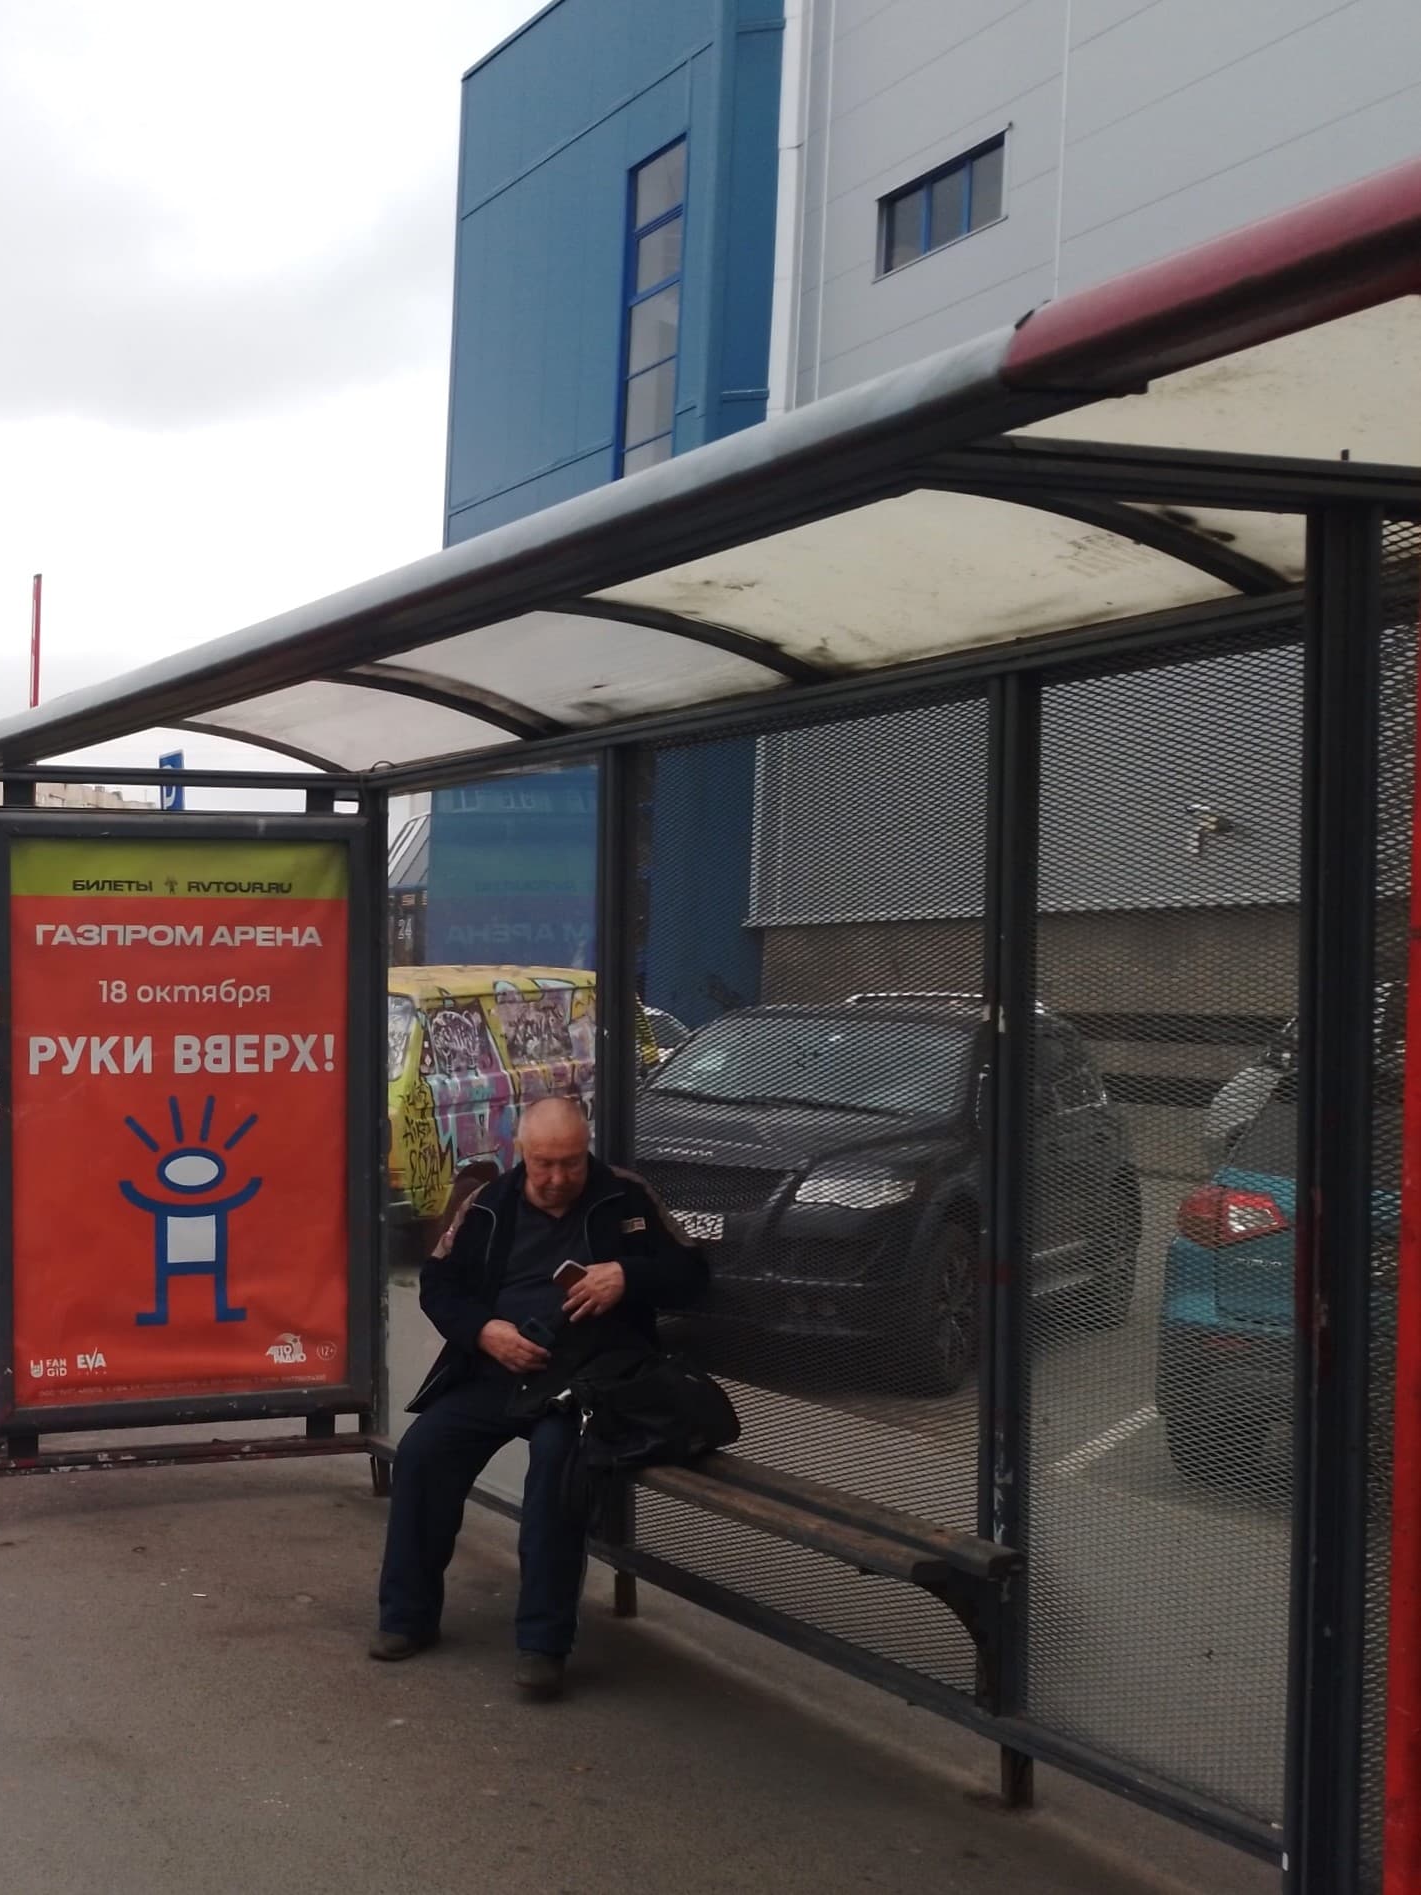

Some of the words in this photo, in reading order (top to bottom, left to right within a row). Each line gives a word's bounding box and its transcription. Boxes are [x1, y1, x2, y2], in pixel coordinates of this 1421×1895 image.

[72, 879, 153, 892] БИЛЕТЫ
[187, 881, 293, 894] RVTOUR.RU
[35, 924, 204, 946] ГАЗПРОМ
[209, 926, 323, 947] АРЕНА
[98, 980, 128, 1003] 18
[136, 978, 271, 1008] октября
[28, 1035, 153, 1075] РУКИ
[173, 1033, 335, 1074] ВВЕРХ!
[46, 1358, 67, 1368] FAN
[76, 1346, 108, 1373] EVA
